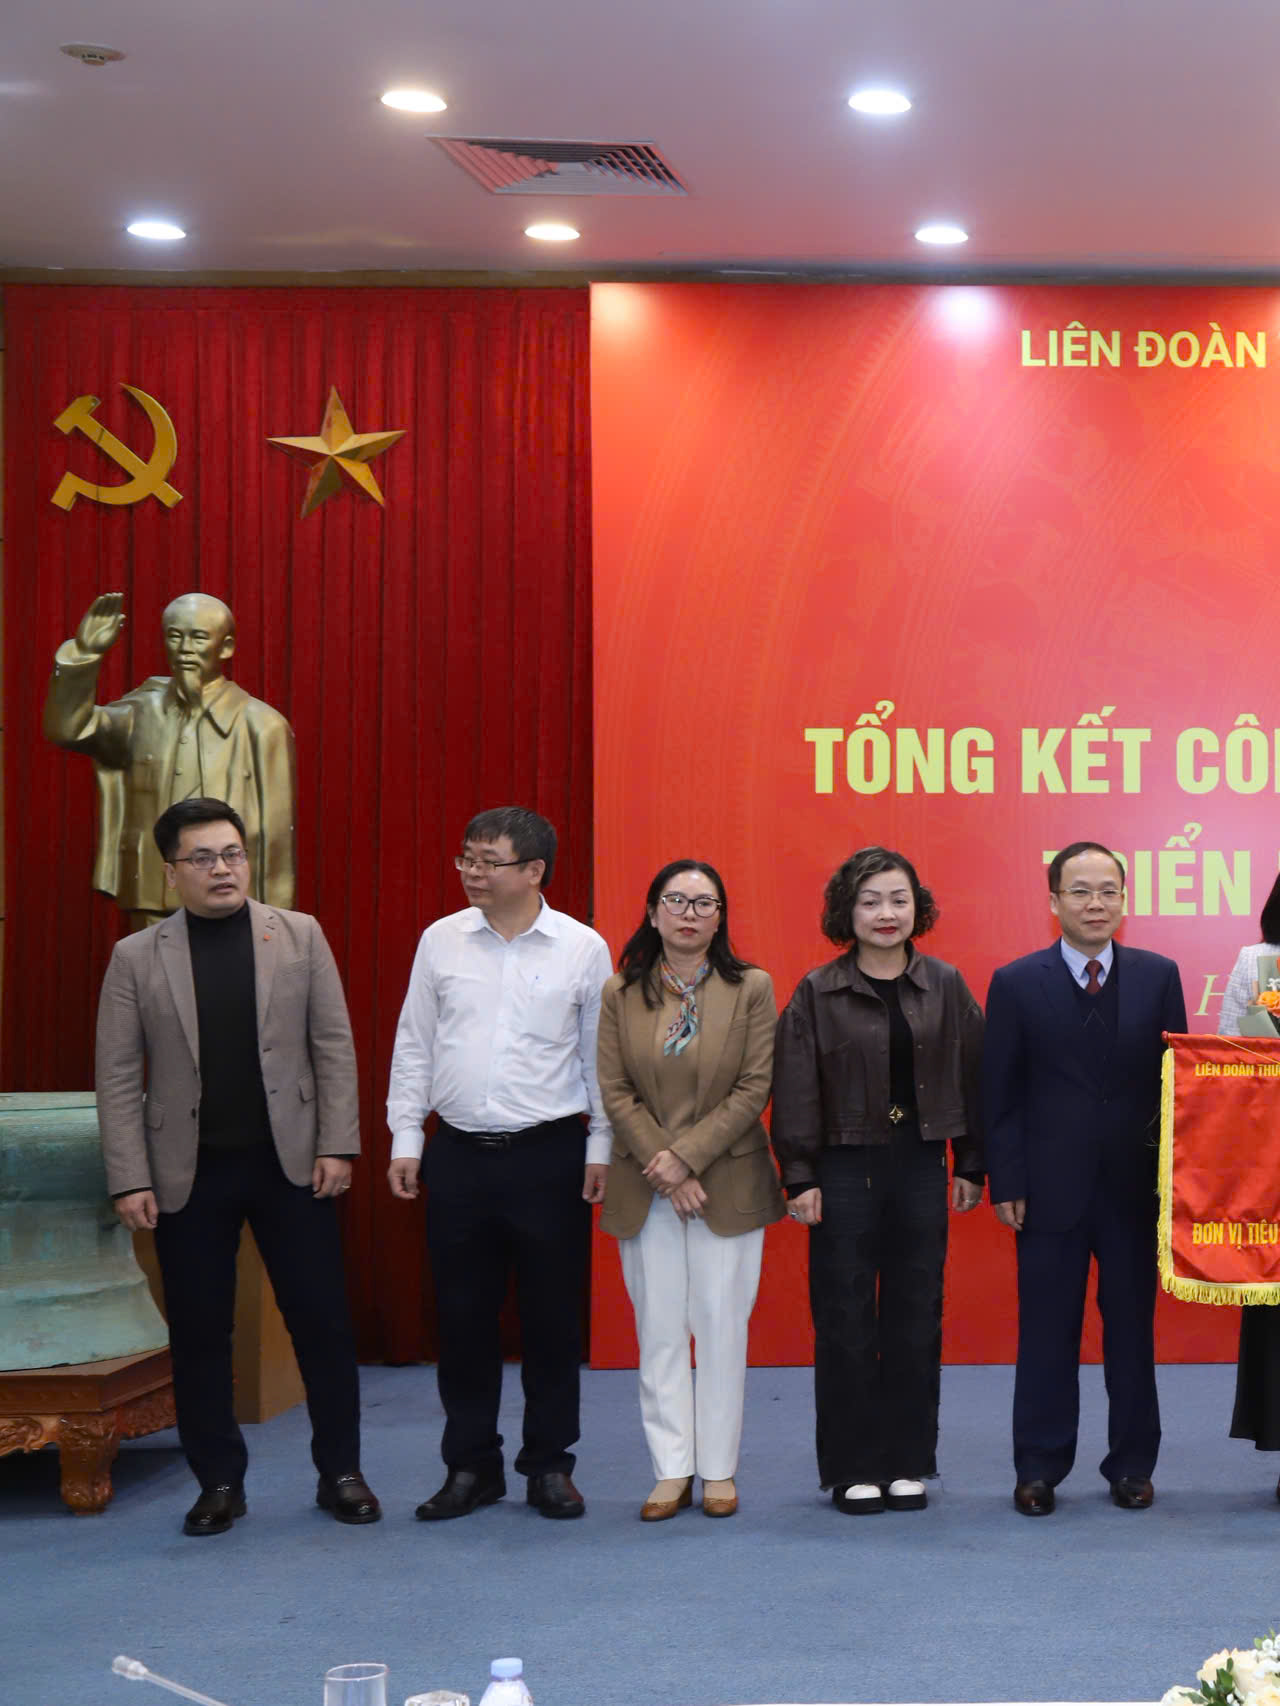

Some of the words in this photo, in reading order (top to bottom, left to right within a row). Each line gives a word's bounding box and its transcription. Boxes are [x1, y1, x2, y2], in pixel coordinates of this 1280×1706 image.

[1020, 320, 1121, 368] LIÊN
[1134, 321, 1267, 369] ĐOÀN
[803, 699, 995, 795] TỔNG
[1021, 705, 1152, 795] KẾT
[1042, 822, 1251, 916] IỂN
[1195, 1061, 1221, 1077] LIÊN
[1192, 1220, 1224, 1245] ĐƠN
[1228, 1222, 1243, 1250] VỊ
[1247, 1219, 1279, 1245] TIÊU
